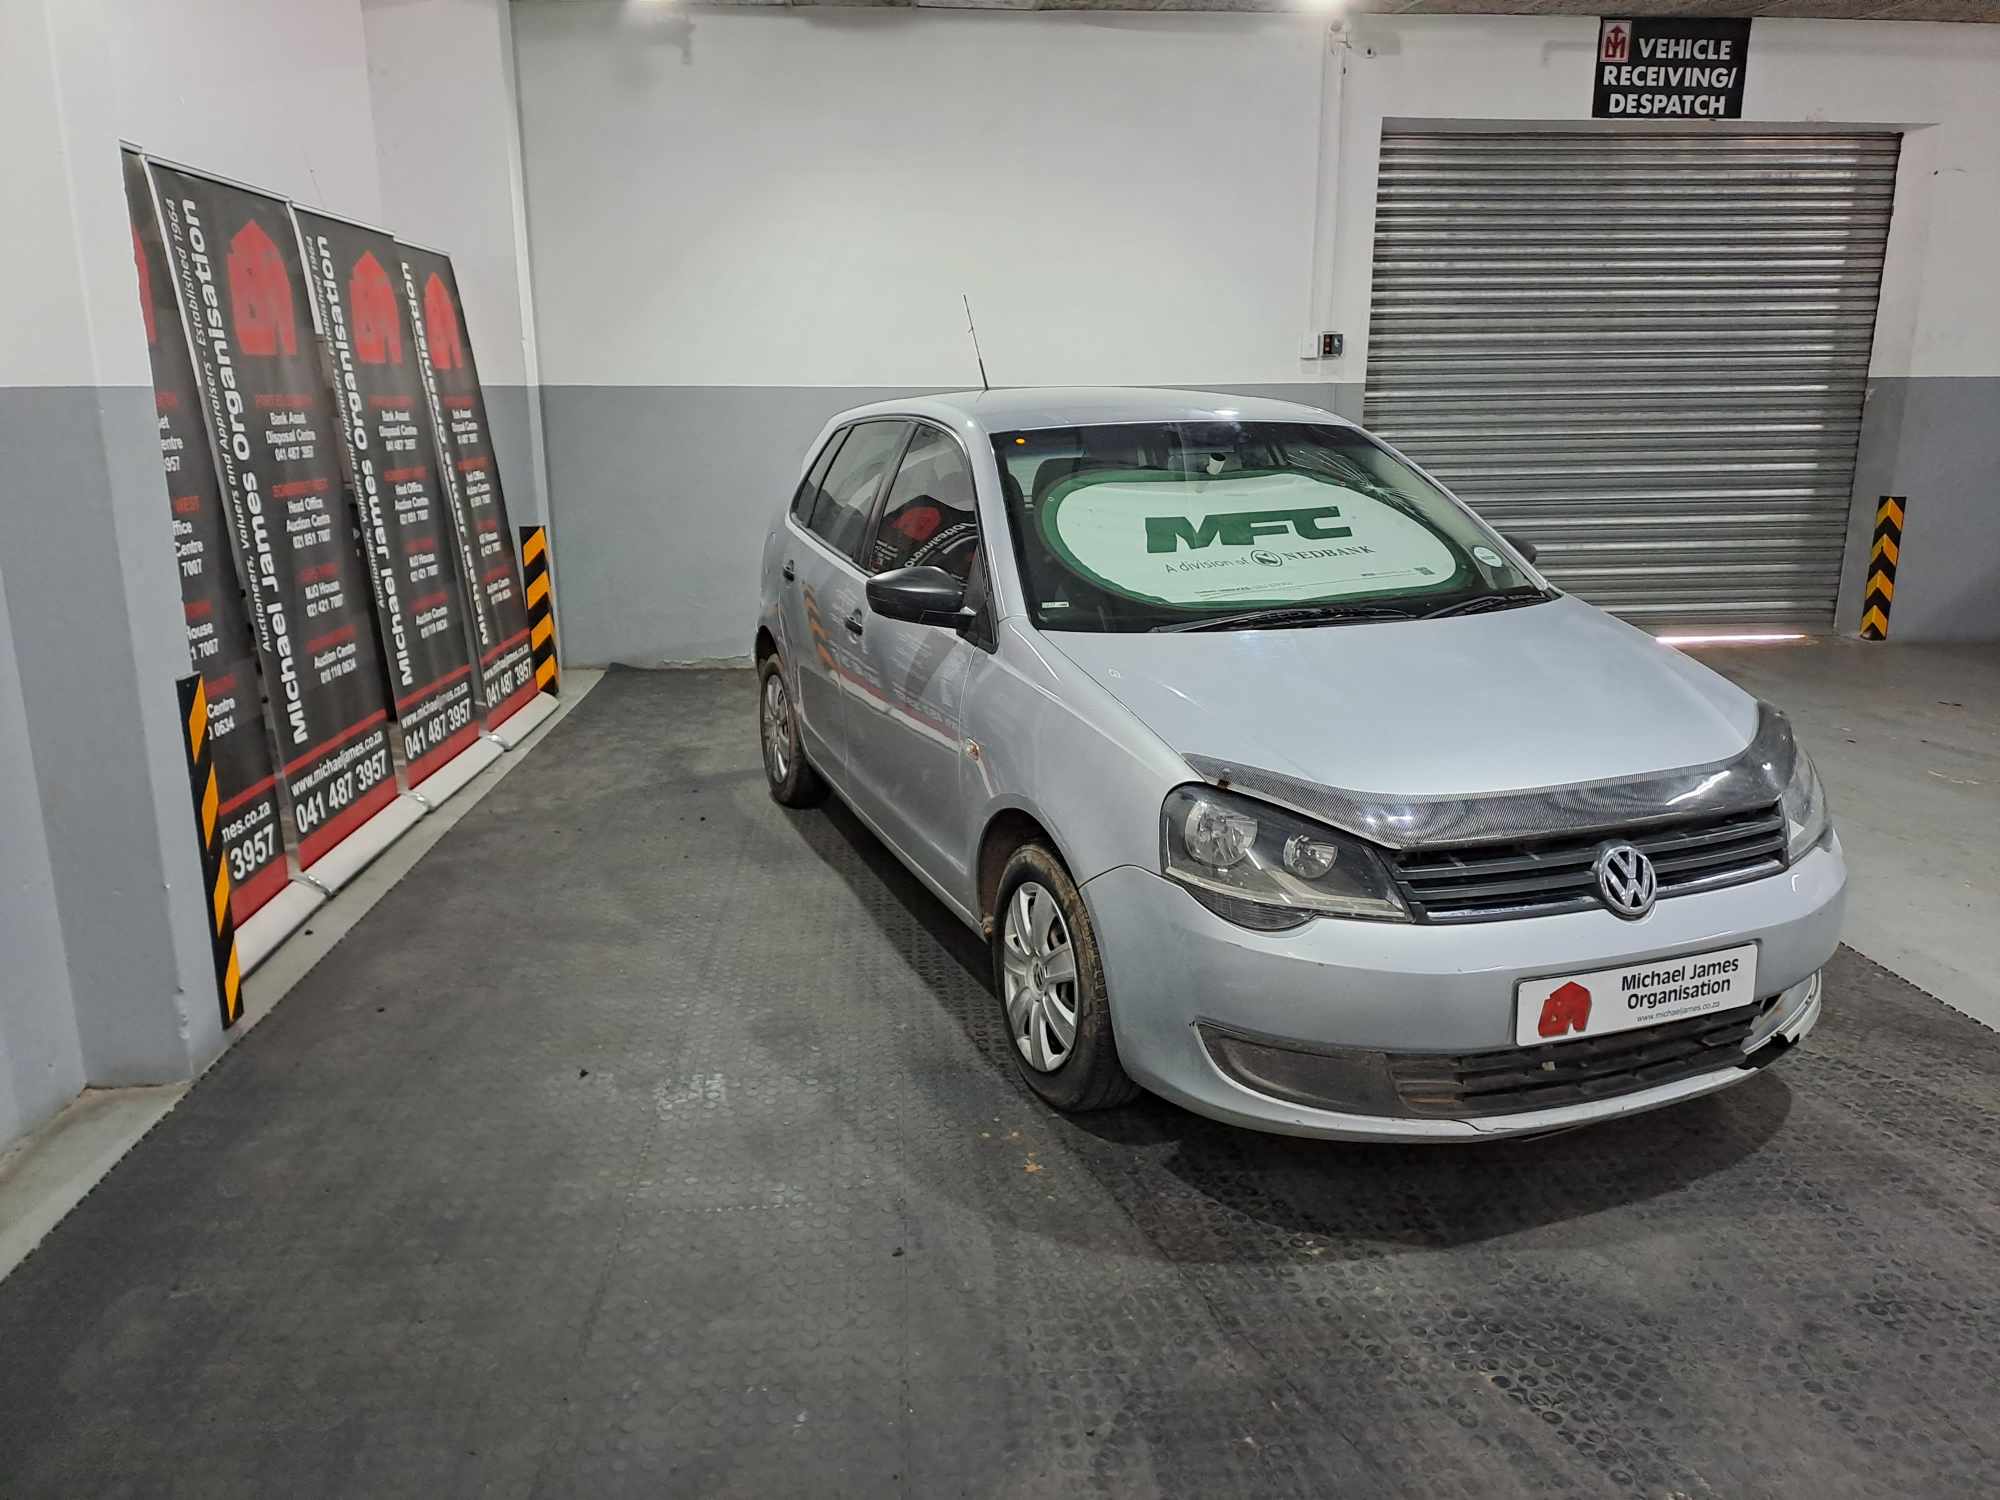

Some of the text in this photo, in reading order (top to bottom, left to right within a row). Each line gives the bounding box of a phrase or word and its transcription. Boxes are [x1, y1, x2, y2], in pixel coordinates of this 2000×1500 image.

[1638, 38, 1732, 60] VEHICLE
[1602, 65, 1738, 89] RECEIVING/
[1608, 93, 1726, 115] DESPATCH
[165, 198, 183, 242] 1964
[176, 245, 208, 348] Established
[206, 362, 230, 450] Appraisers
[161, 436, 184, 451] entre
[165, 456, 181, 472] 957
[317, 235, 413, 687] Michael James Organisation
[182, 199, 309, 745] Michael James Organisation
[221, 453, 237, 486] and
[231, 489, 251, 550] Valuers
[1145, 506, 1353, 554] MFC
[174, 541, 205, 557] Centre
[1165, 563, 1178, 575] A
[1179, 558, 1234, 573] division
[1281, 545, 1377, 561] NEDBANK
[485, 657, 533, 709] 041 487 3957
[207, 697, 236, 720] Centre
[404, 698, 471, 760] 041 487 3957
[290, 730, 384, 797] www.michaeljames.co.za
[295, 748, 387, 833] 041 487 3957
[230, 822, 275, 881] 3957
[1621, 957, 1740, 992] Michael James
[1627, 977, 1732, 1011] Organisation
